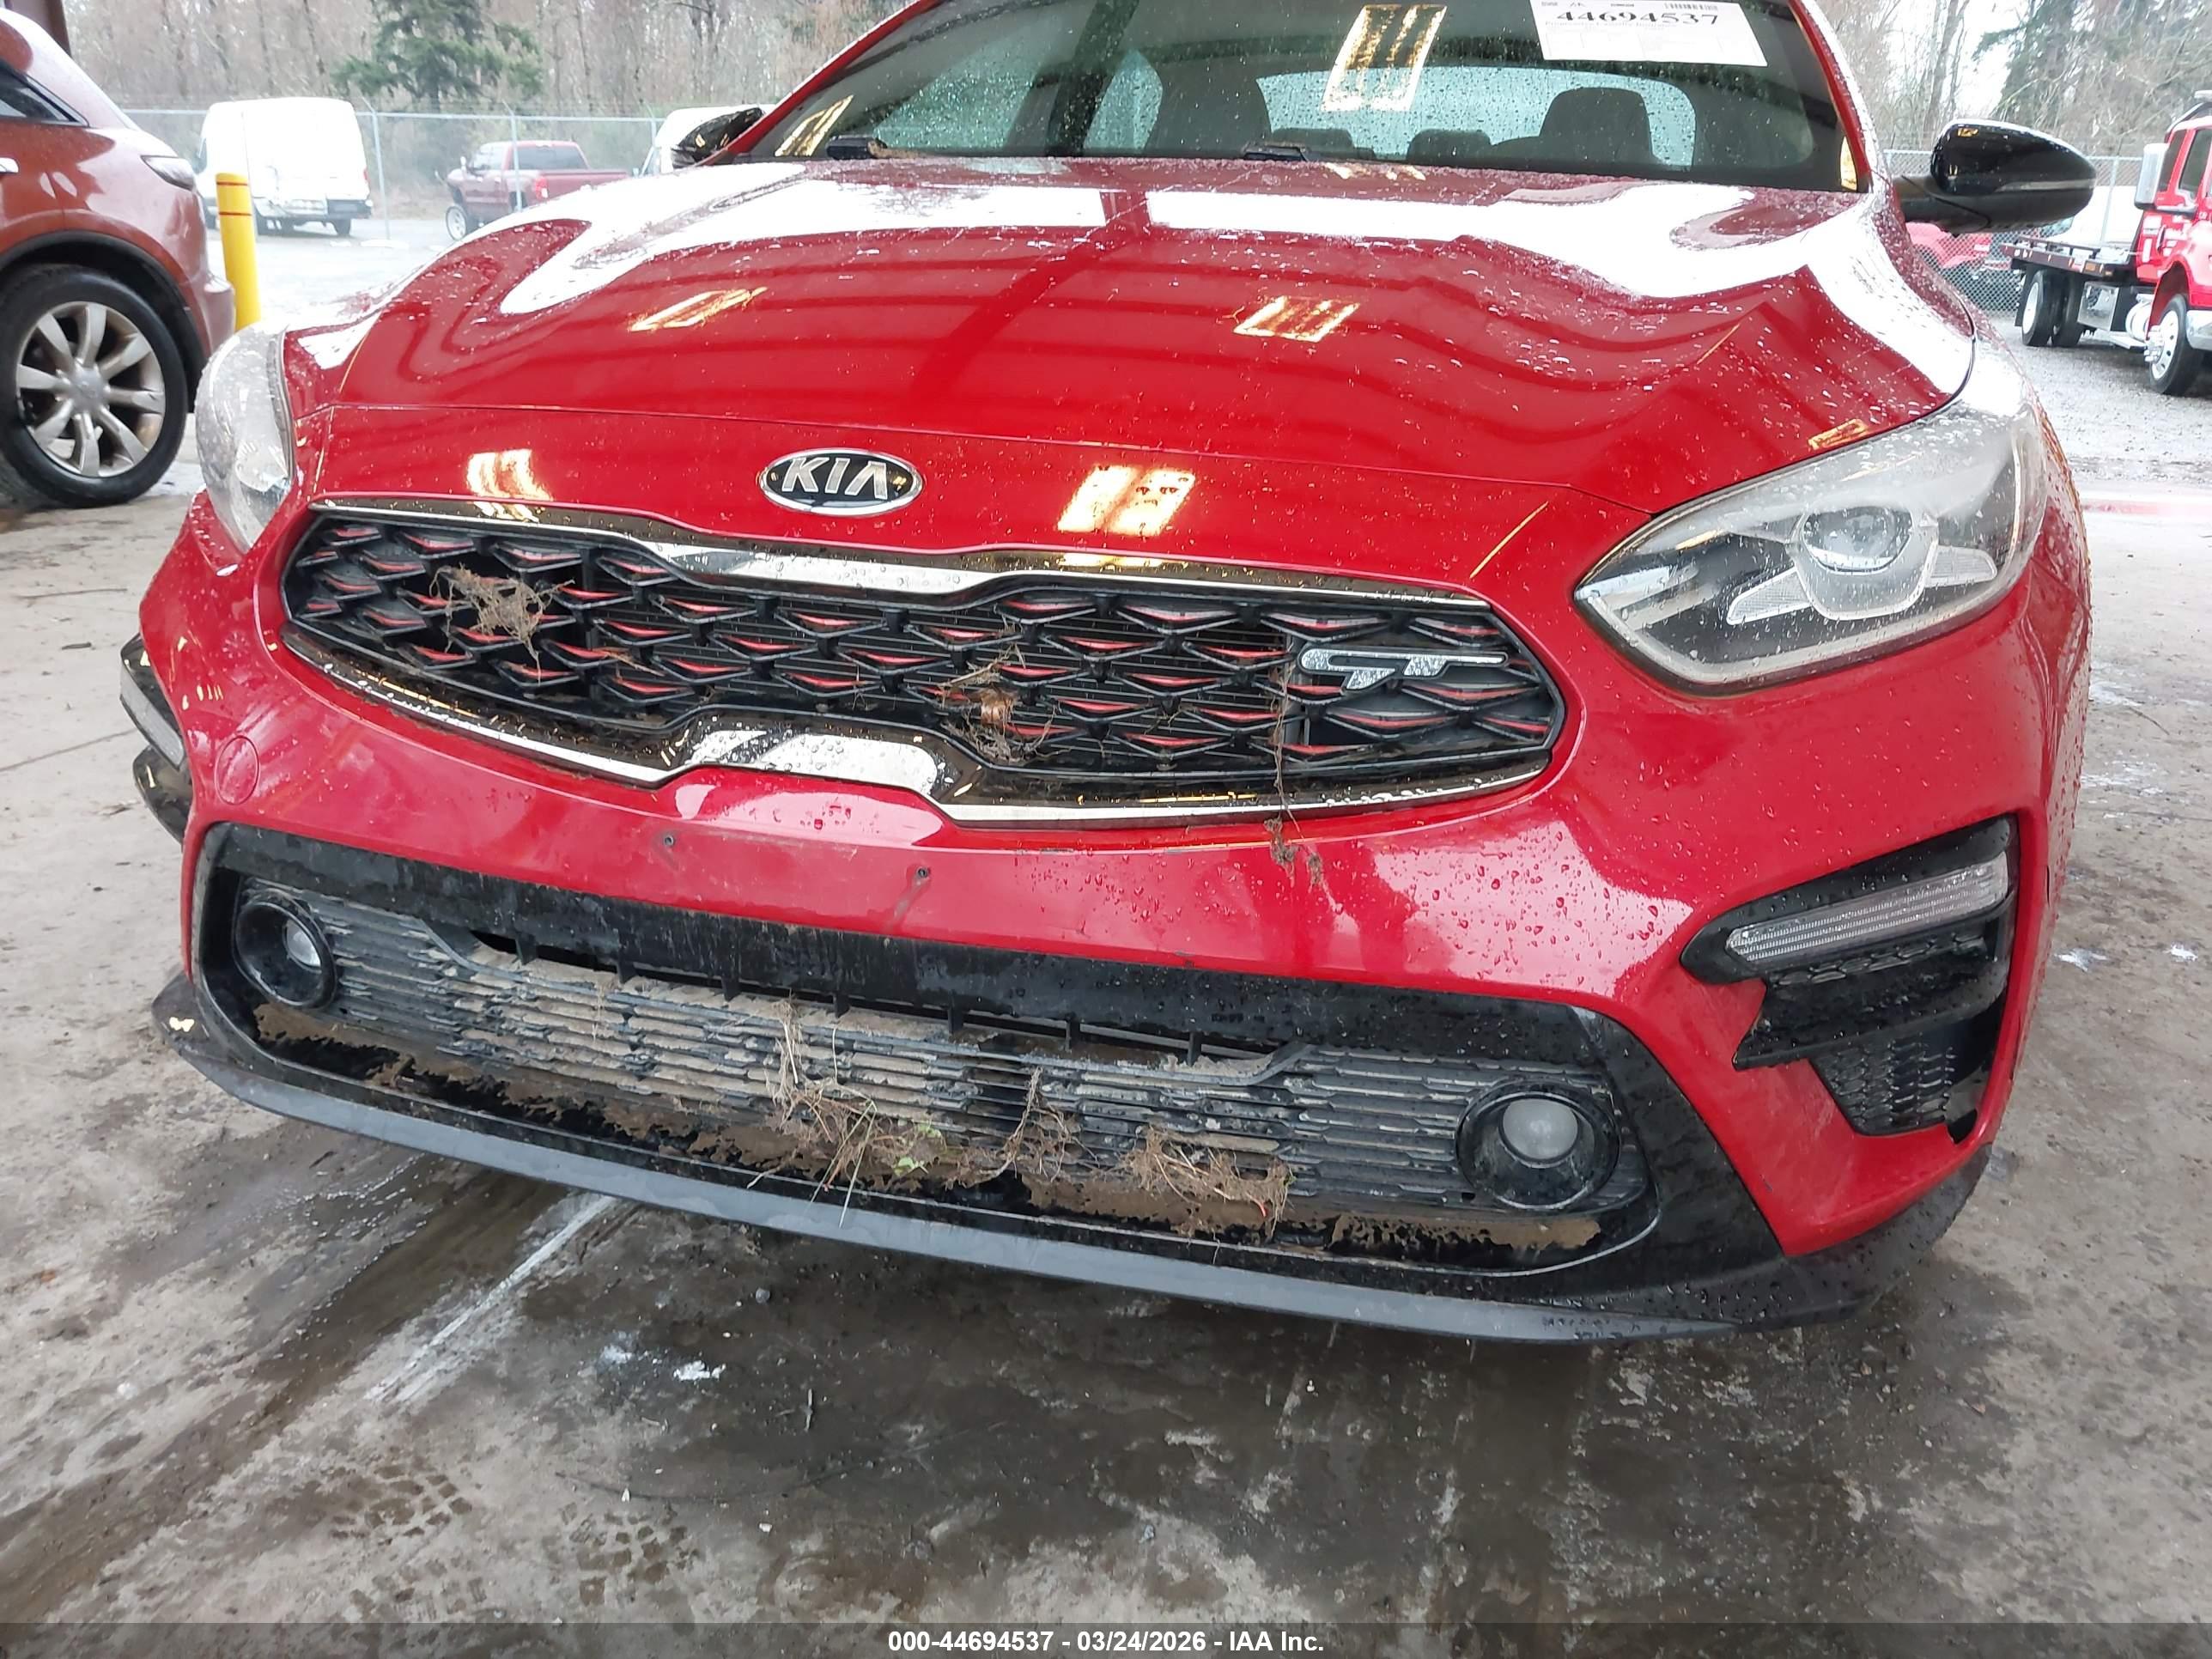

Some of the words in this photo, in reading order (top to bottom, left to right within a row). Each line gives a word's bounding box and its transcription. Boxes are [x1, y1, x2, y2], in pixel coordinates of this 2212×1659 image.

[1556, 10, 1718, 26] 44694537
[781, 456, 888, 500] KIA
[1299, 647, 1504, 690] GT
